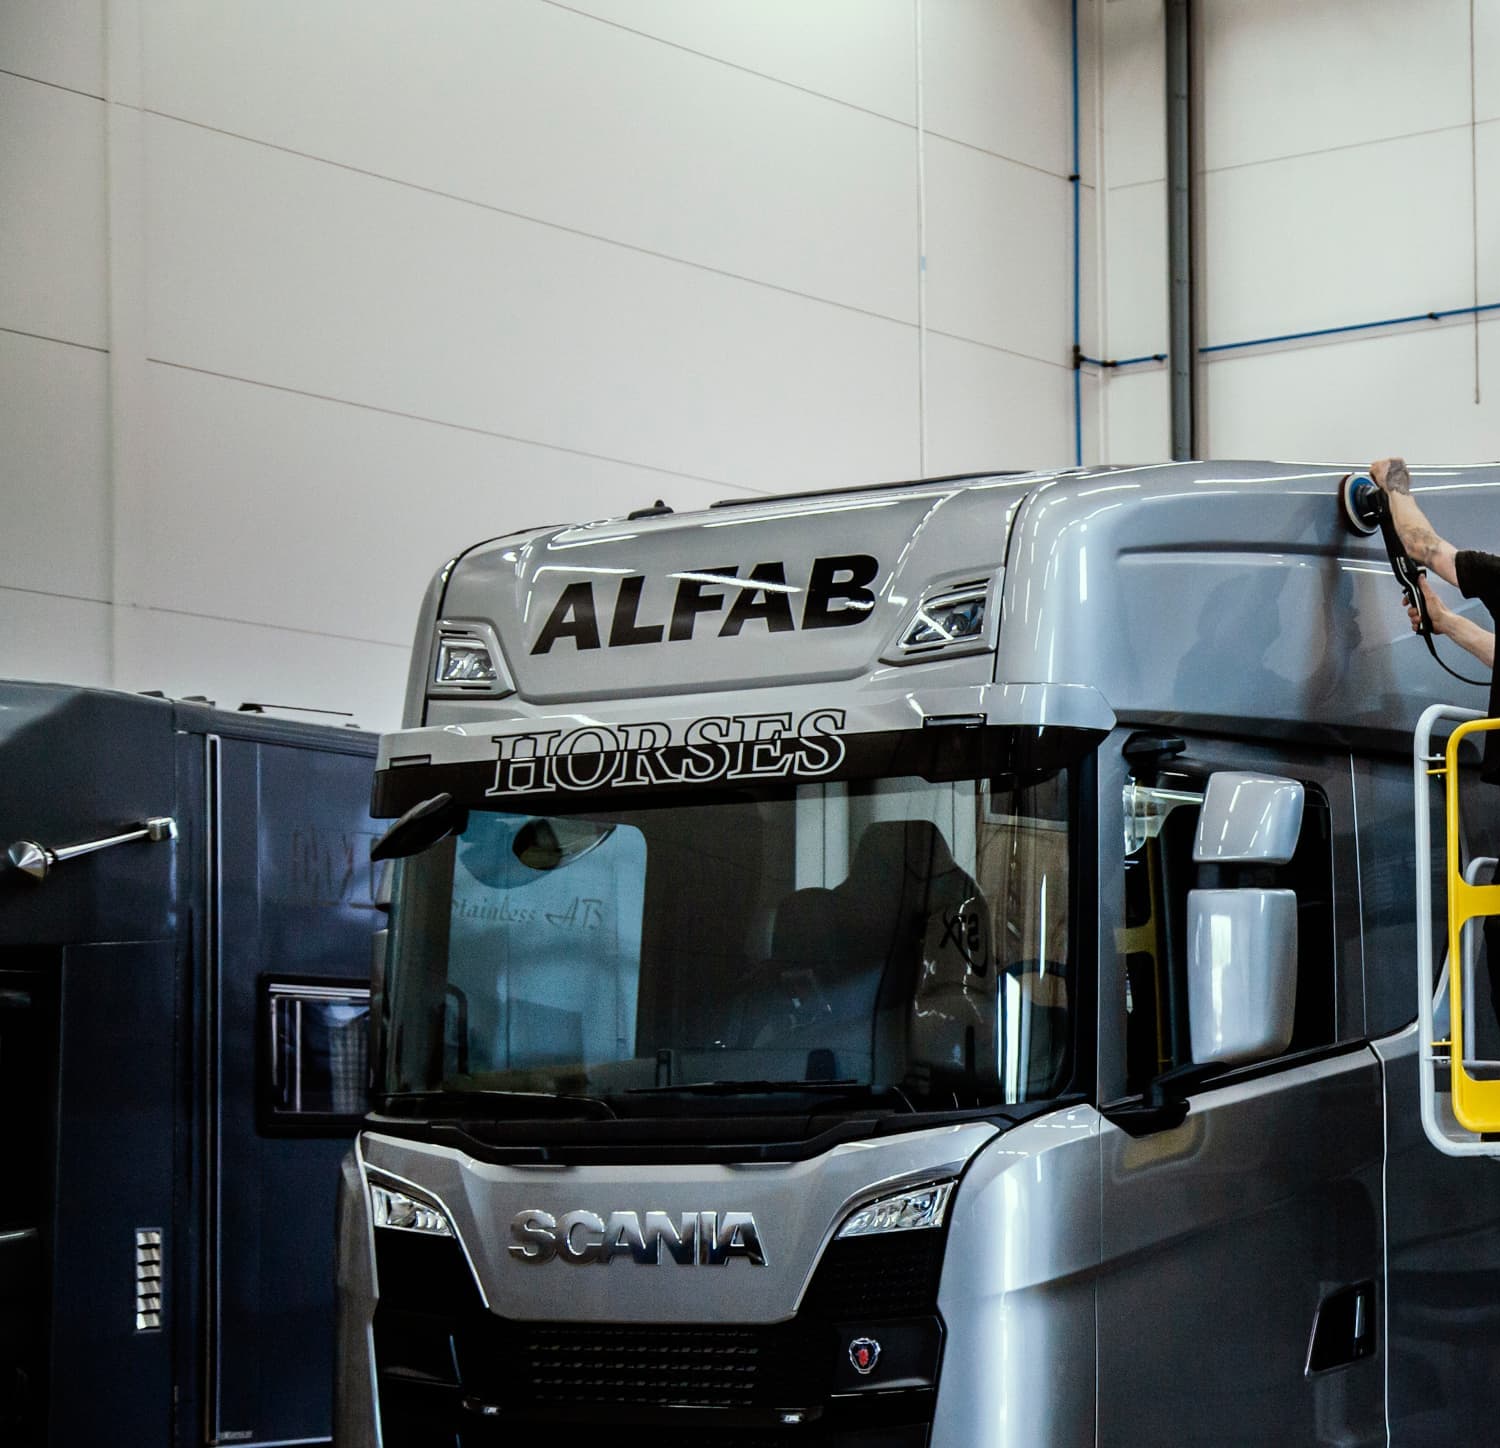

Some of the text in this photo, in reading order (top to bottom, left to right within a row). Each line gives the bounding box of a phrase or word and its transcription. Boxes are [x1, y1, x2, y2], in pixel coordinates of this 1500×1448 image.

[531, 554, 879, 655] ALFAB
[485, 708, 847, 797] HORSES
[507, 1209, 768, 1267] SCANIA
